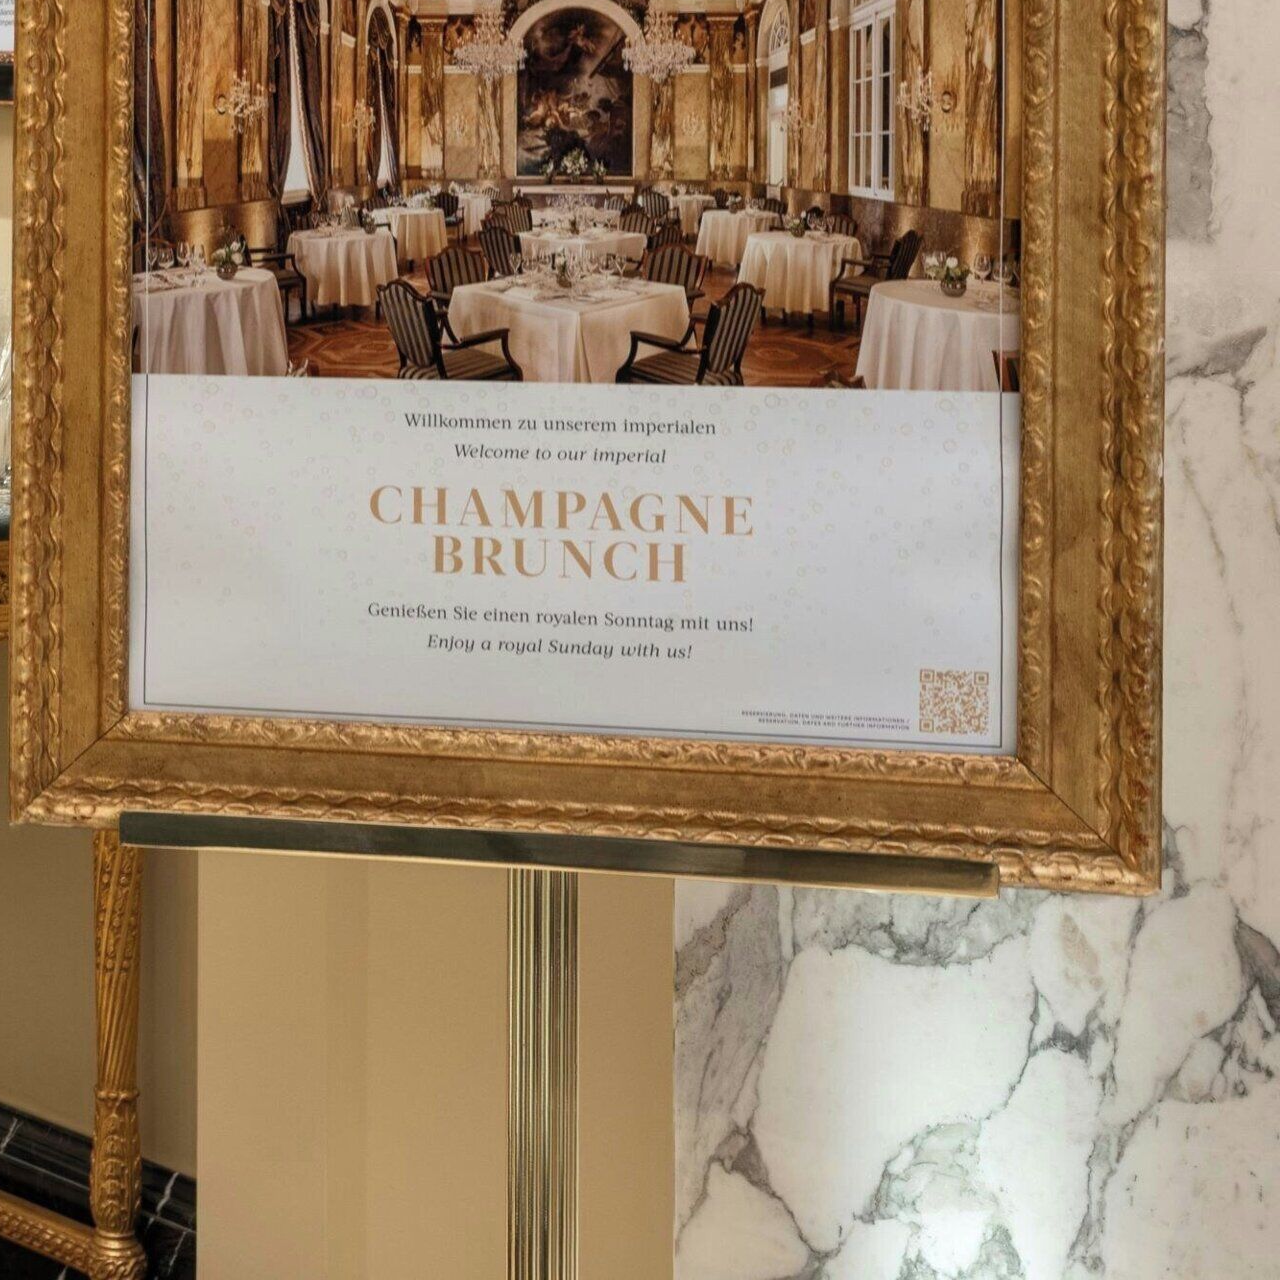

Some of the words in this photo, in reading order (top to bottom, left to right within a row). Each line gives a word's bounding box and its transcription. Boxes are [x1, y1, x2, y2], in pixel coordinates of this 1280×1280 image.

[404, 413, 511, 430] Willkommen
[518, 419, 536, 431] zu
[544, 419, 616, 433] unserem
[624, 417, 716, 436] imperialen
[454, 444, 529, 460] Welcome
[536, 447, 552, 460] to
[557, 450, 587, 461] our
[593, 447, 666, 465] imperial
[369, 484, 754, 536] CHAMPAGNE
[432, 535, 688, 582] BRUNCH
[368, 602, 447, 620] Genießen
[453, 605, 478, 621] Sie
[483, 608, 529, 623] einen
[536, 609, 598, 628] royalen
[604, 612, 674, 632] Sonntag
[680, 614, 710, 630] mit
[716, 617, 754, 632] uns!
[427, 634, 475, 652] Enjoy
[481, 640, 491, 651] a
[498, 638, 542, 656] royal
[548, 640, 614, 659] Sunday
[620, 642, 660, 658] with
[666, 645, 692, 659] us!
